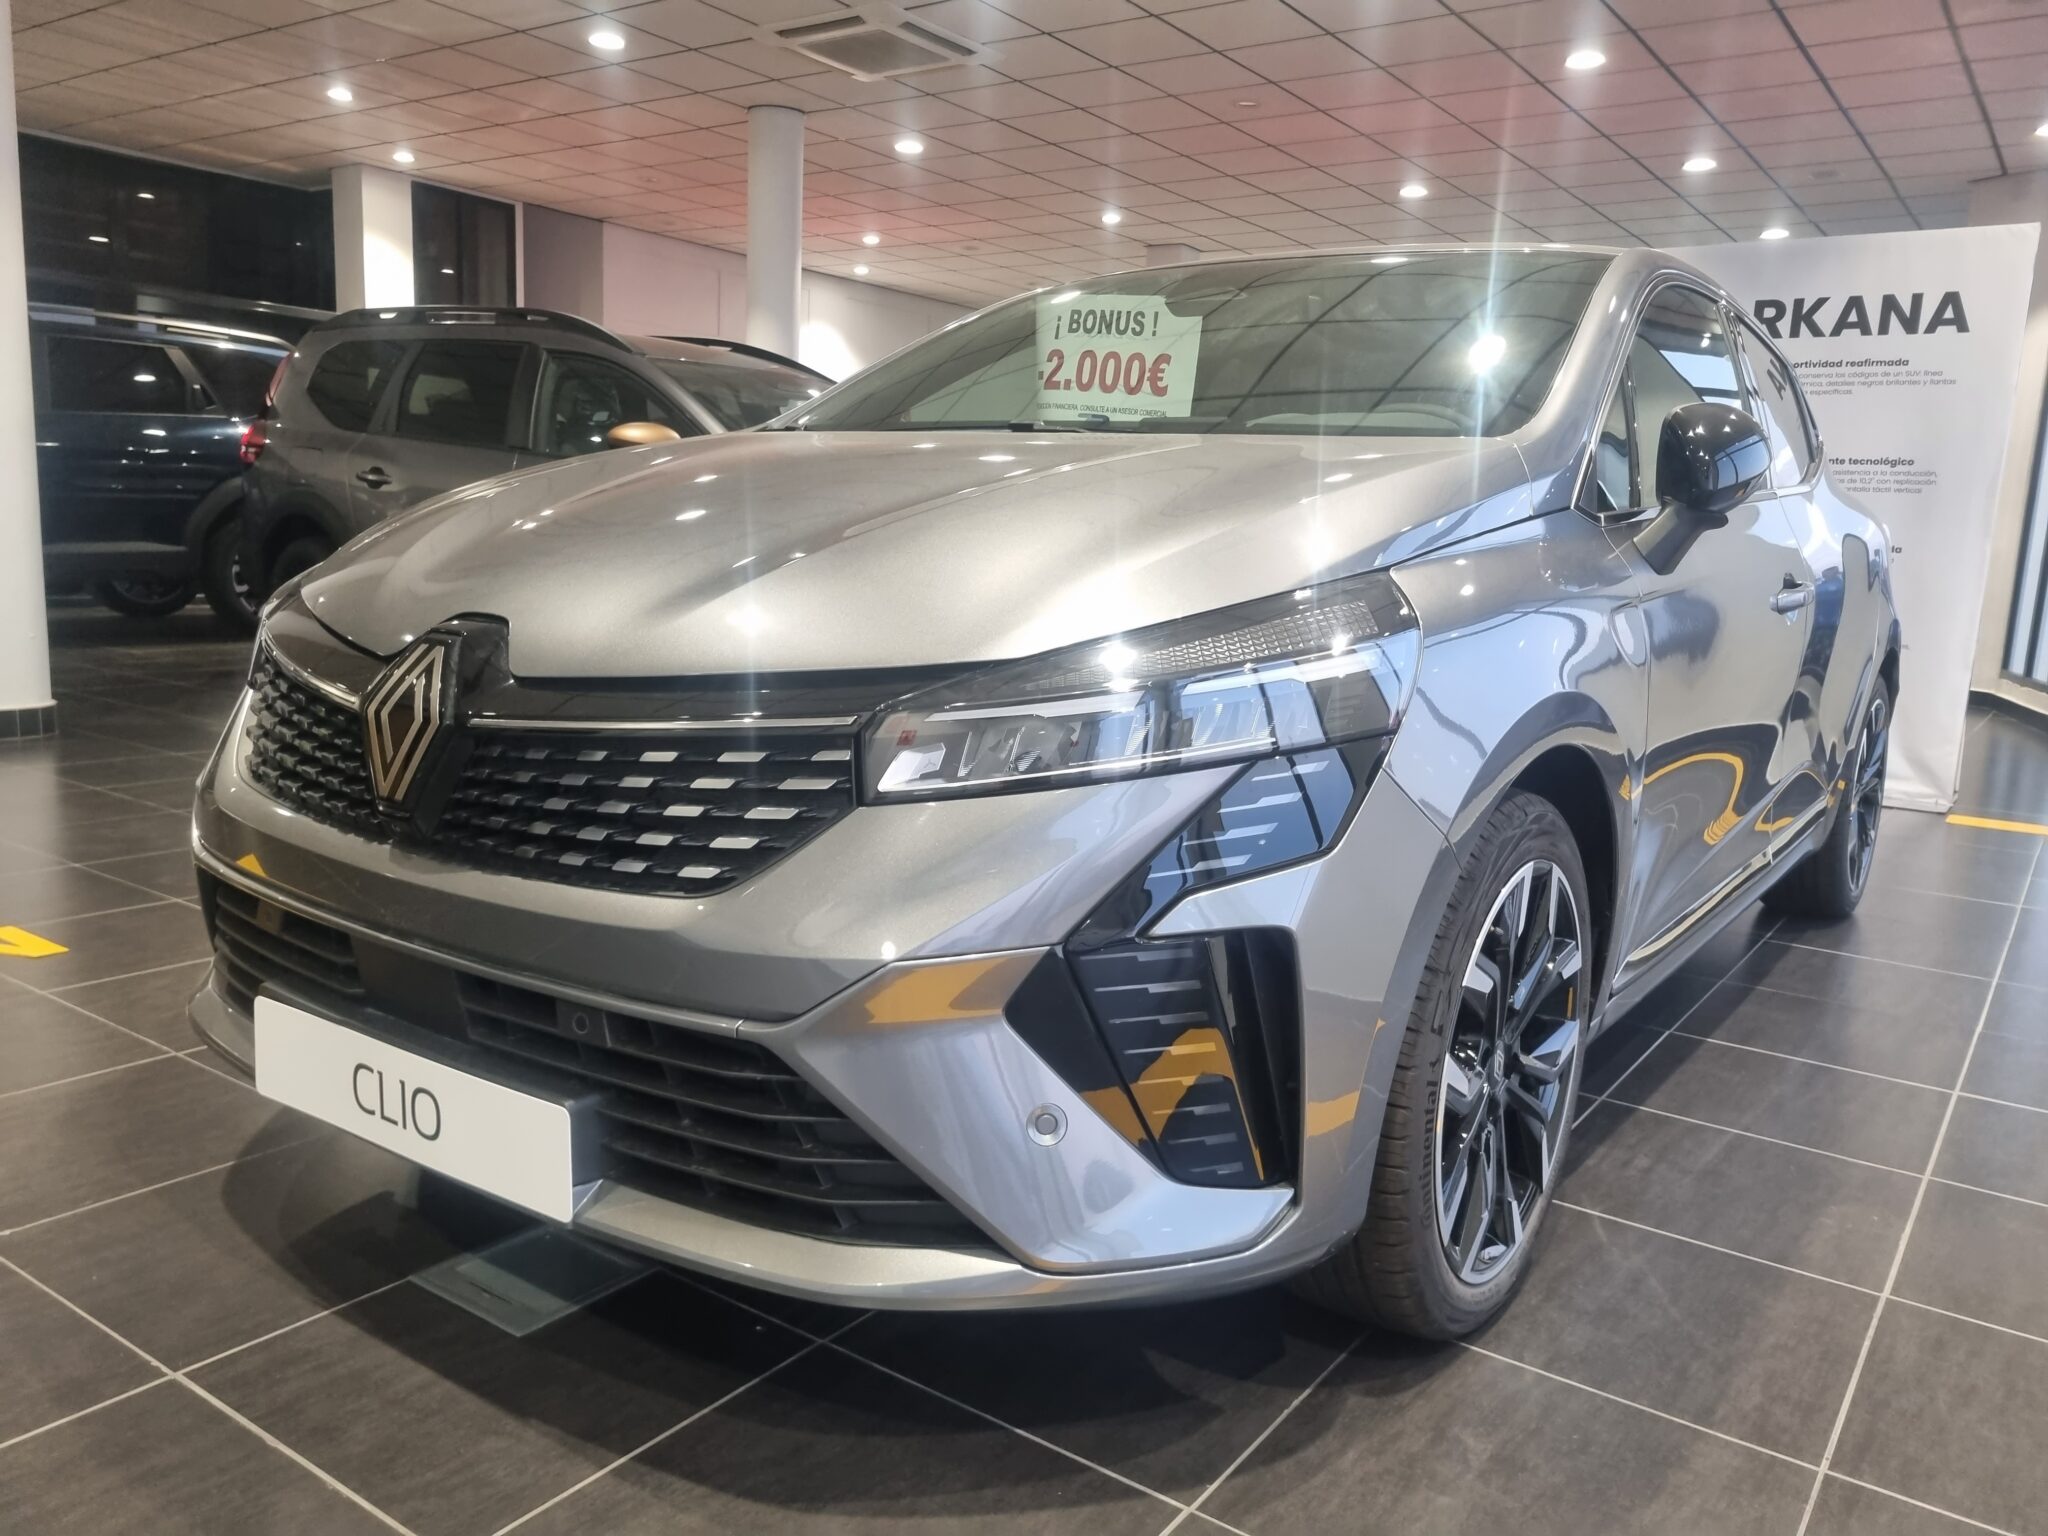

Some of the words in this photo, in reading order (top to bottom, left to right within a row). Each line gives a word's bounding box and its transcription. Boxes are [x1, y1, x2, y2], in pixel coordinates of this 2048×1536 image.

[1067, 309, 1146, 337] BONUS
[1754, 291, 1970, 339] RKANA
[1793, 360, 1843, 369] ortividad
[1845, 358, 1910, 368] reafirmada
[1848, 456, 1915, 469] tecnológico
[353, 1062, 441, 1141] CLIO
